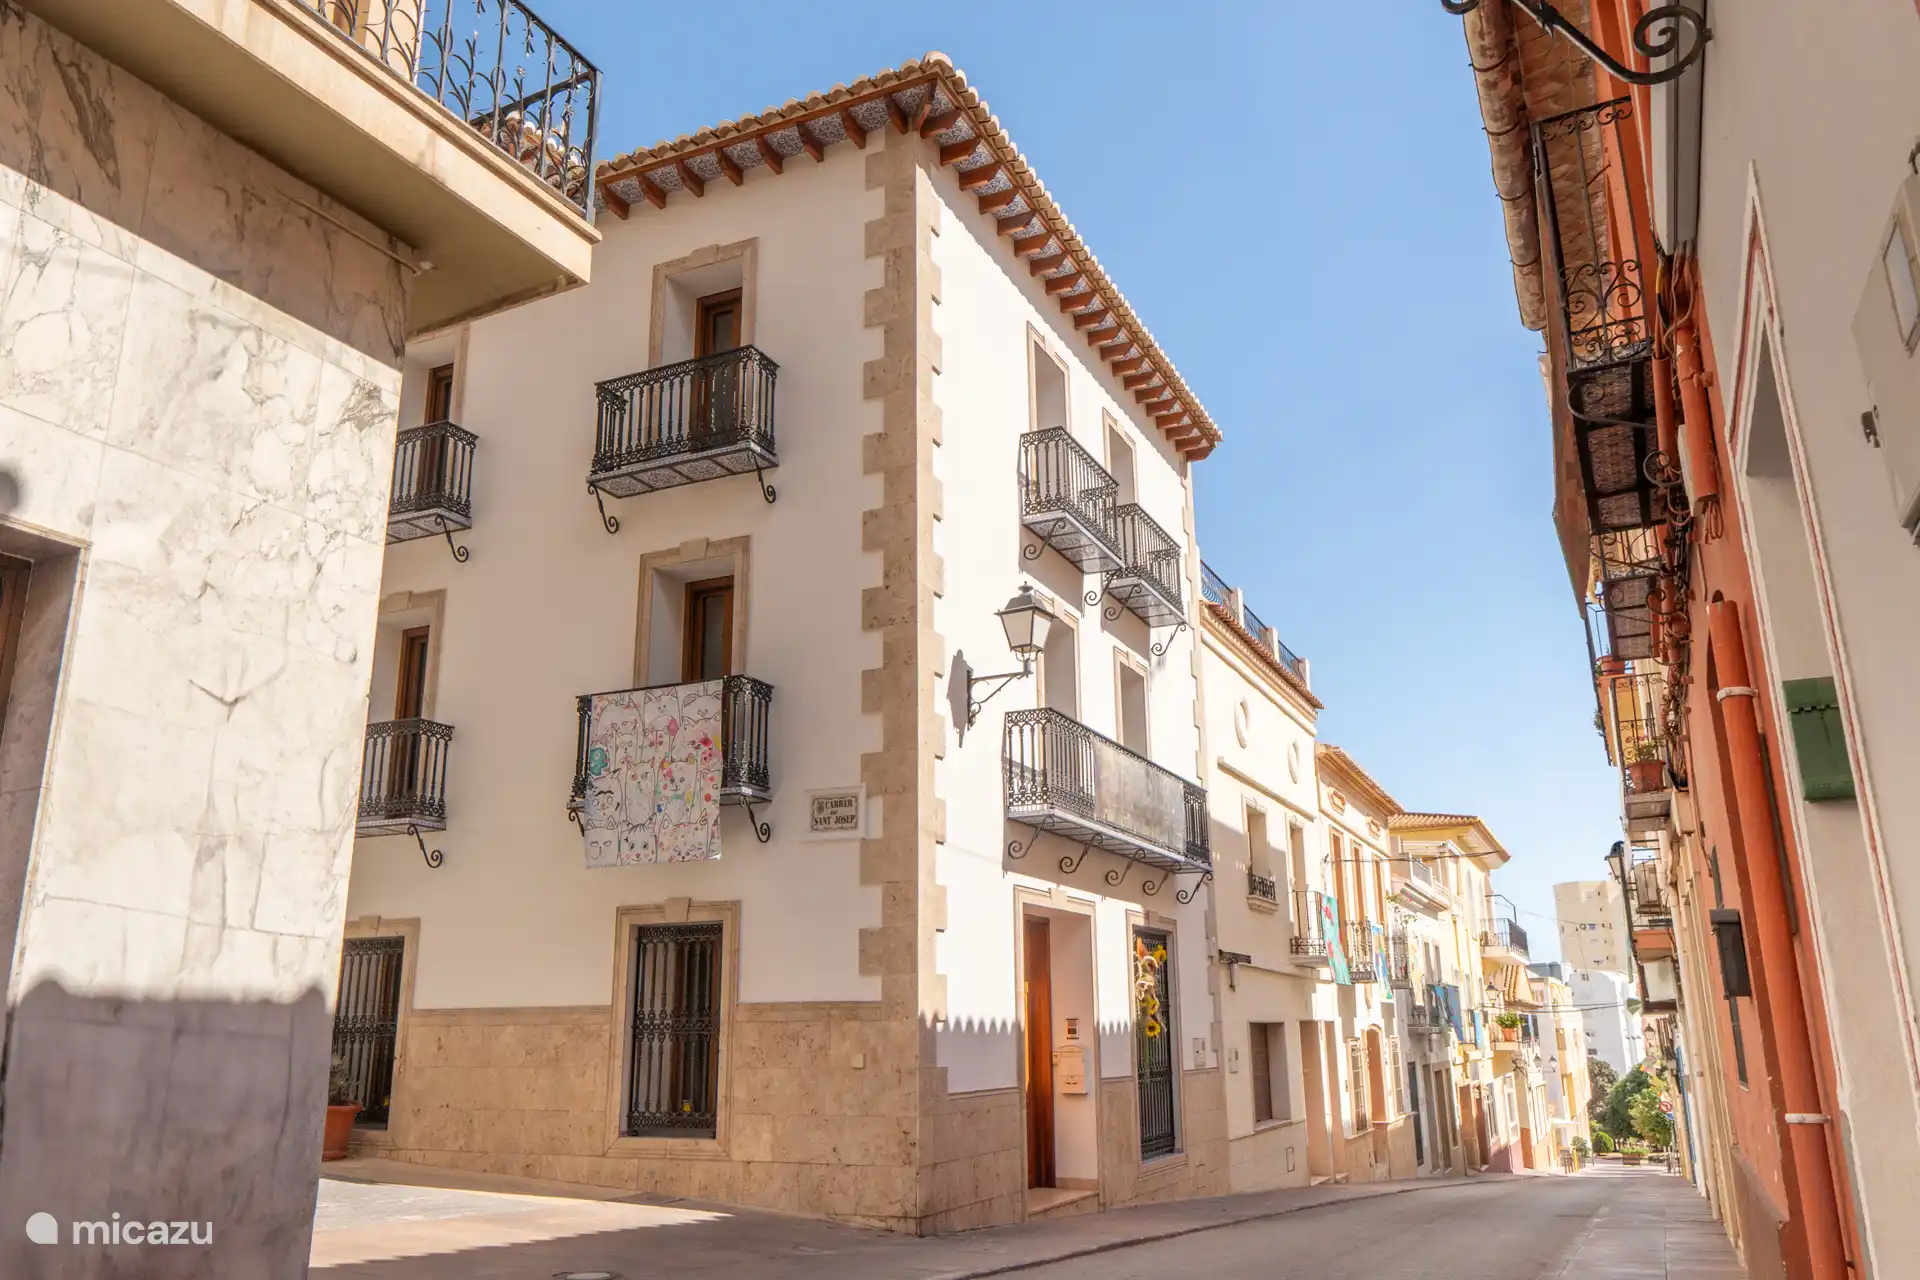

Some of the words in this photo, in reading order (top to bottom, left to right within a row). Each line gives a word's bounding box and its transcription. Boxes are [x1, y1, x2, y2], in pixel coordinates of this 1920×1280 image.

[825, 799, 853, 809] CARRER
[814, 816, 831, 826] SANT
[834, 815, 855, 825] JOSEP
